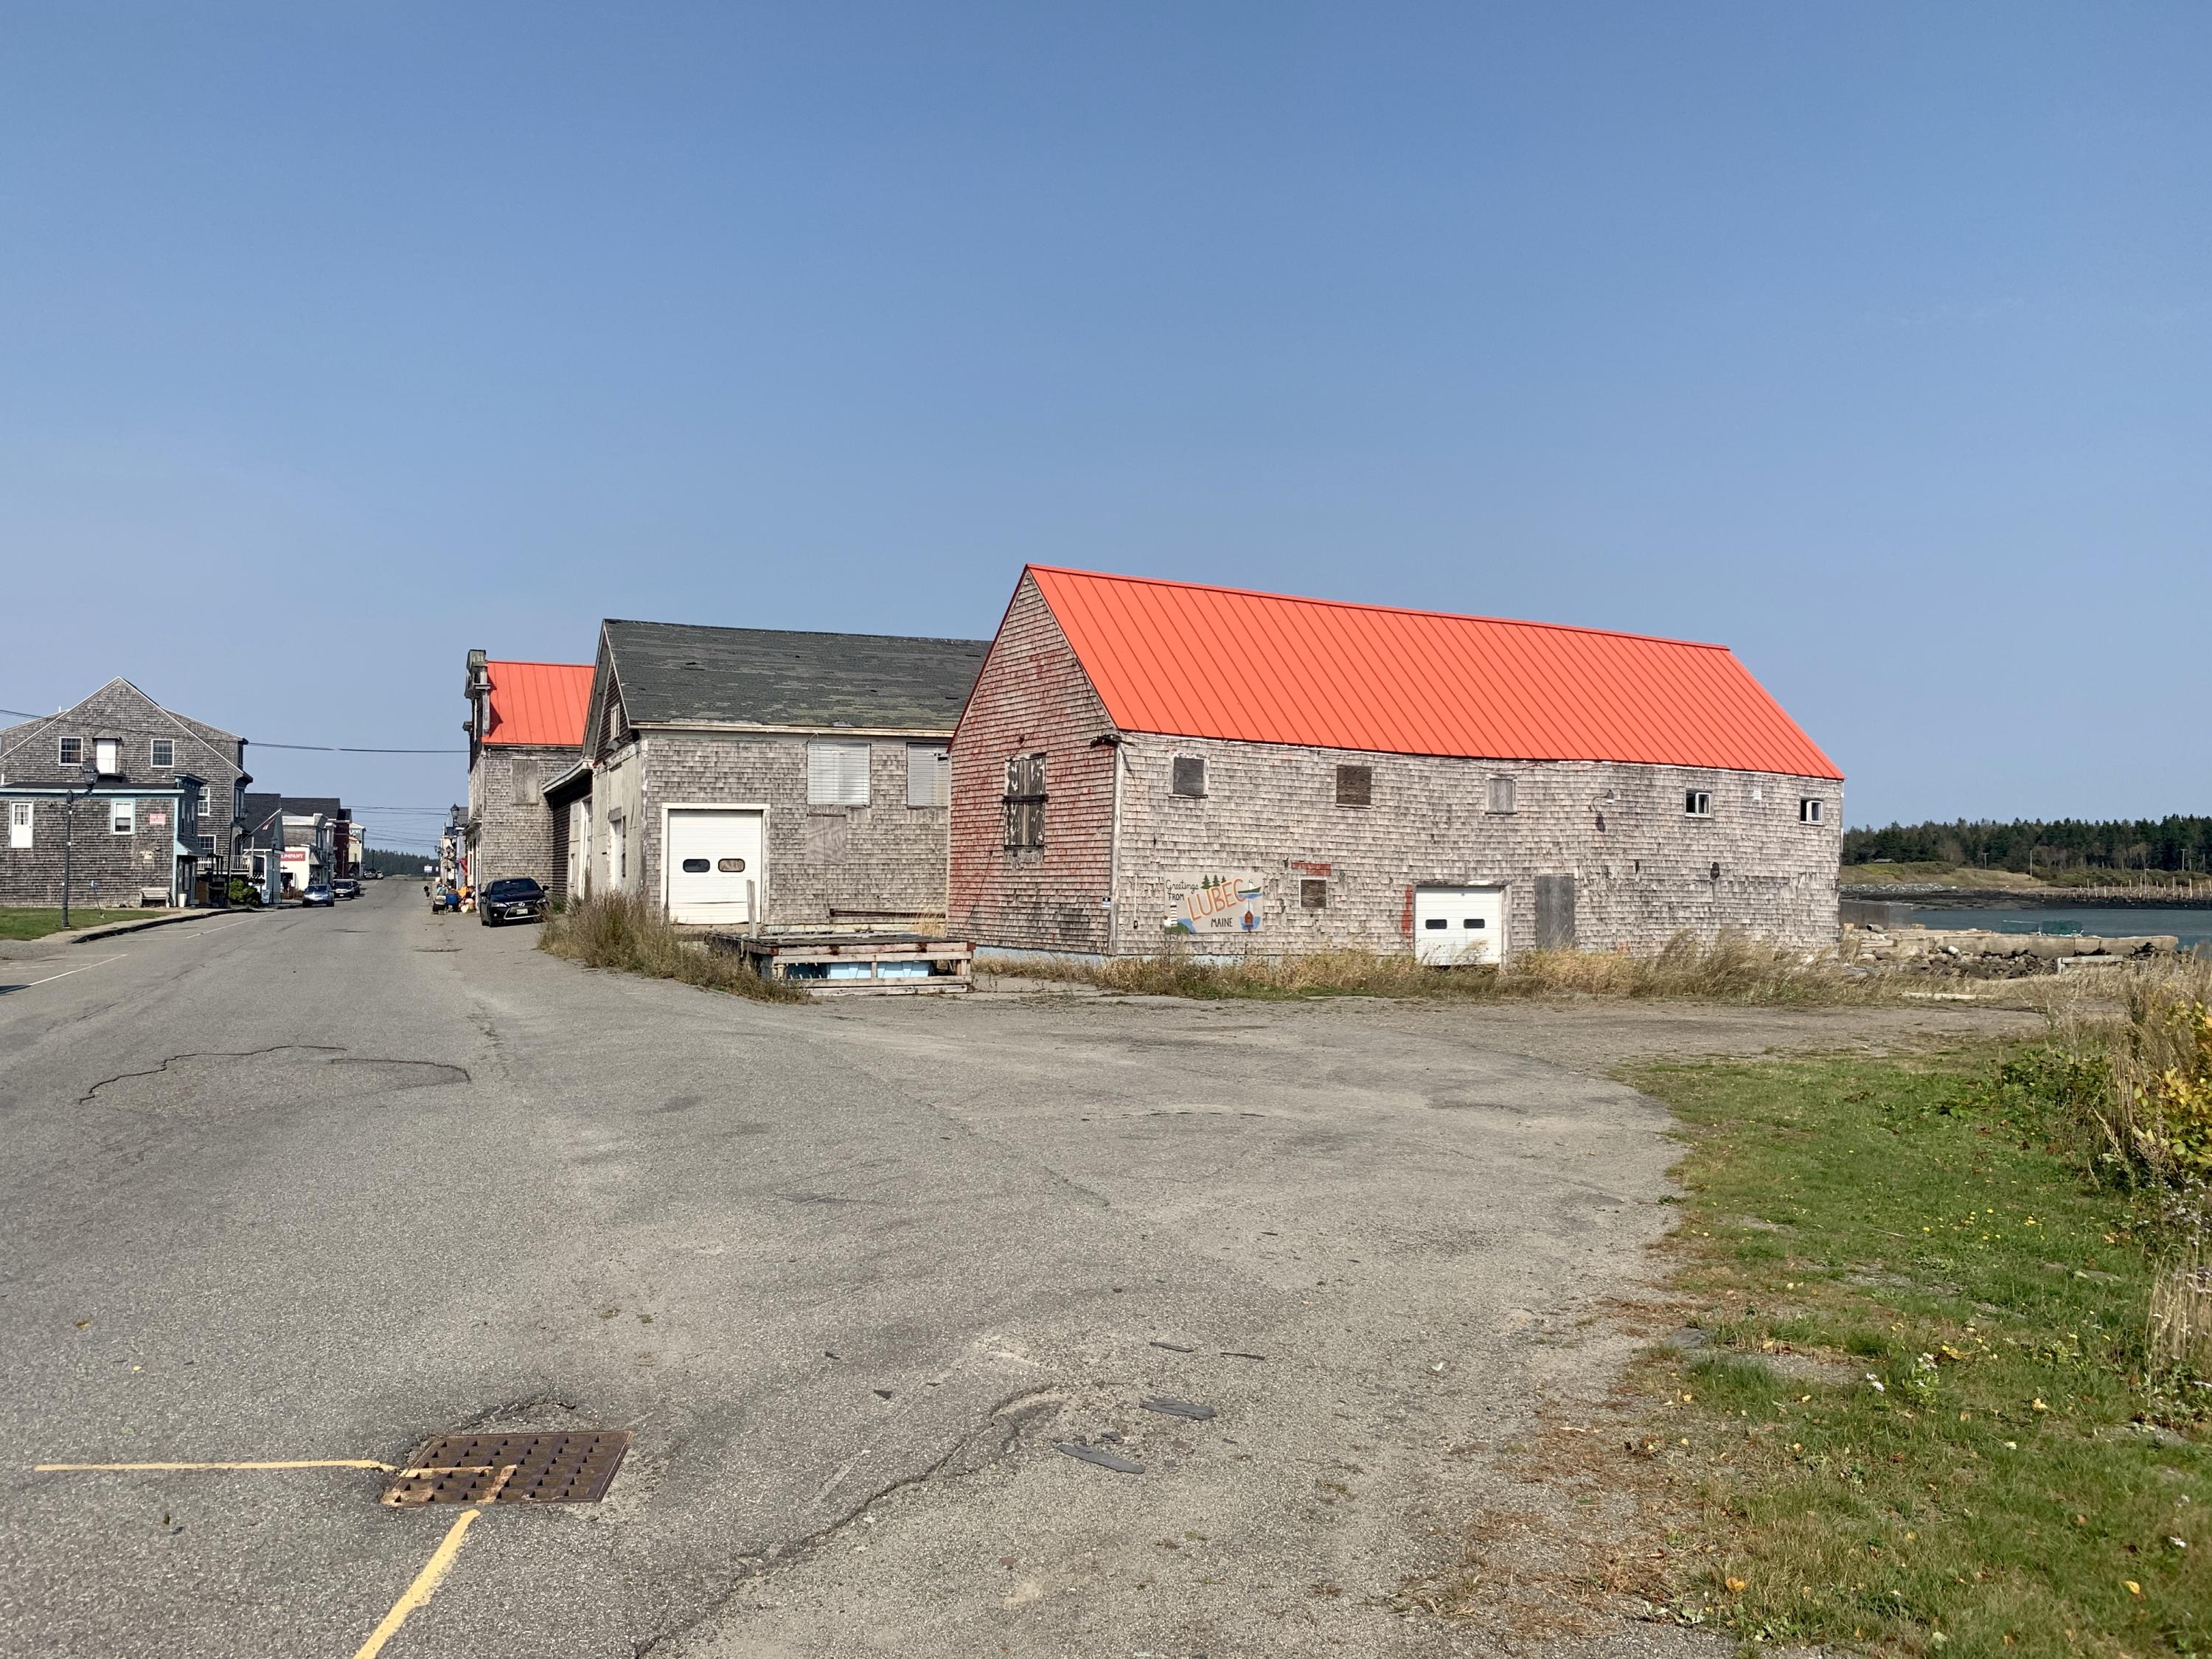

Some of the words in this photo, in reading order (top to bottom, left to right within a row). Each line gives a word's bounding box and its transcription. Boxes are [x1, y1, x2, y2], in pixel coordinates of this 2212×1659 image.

[1165, 880, 1199, 895] Greetings
[1168, 893, 1185, 901] FROM
[1186, 877, 1246, 922] LUBEC
[1211, 917, 1234, 928] MAINE
